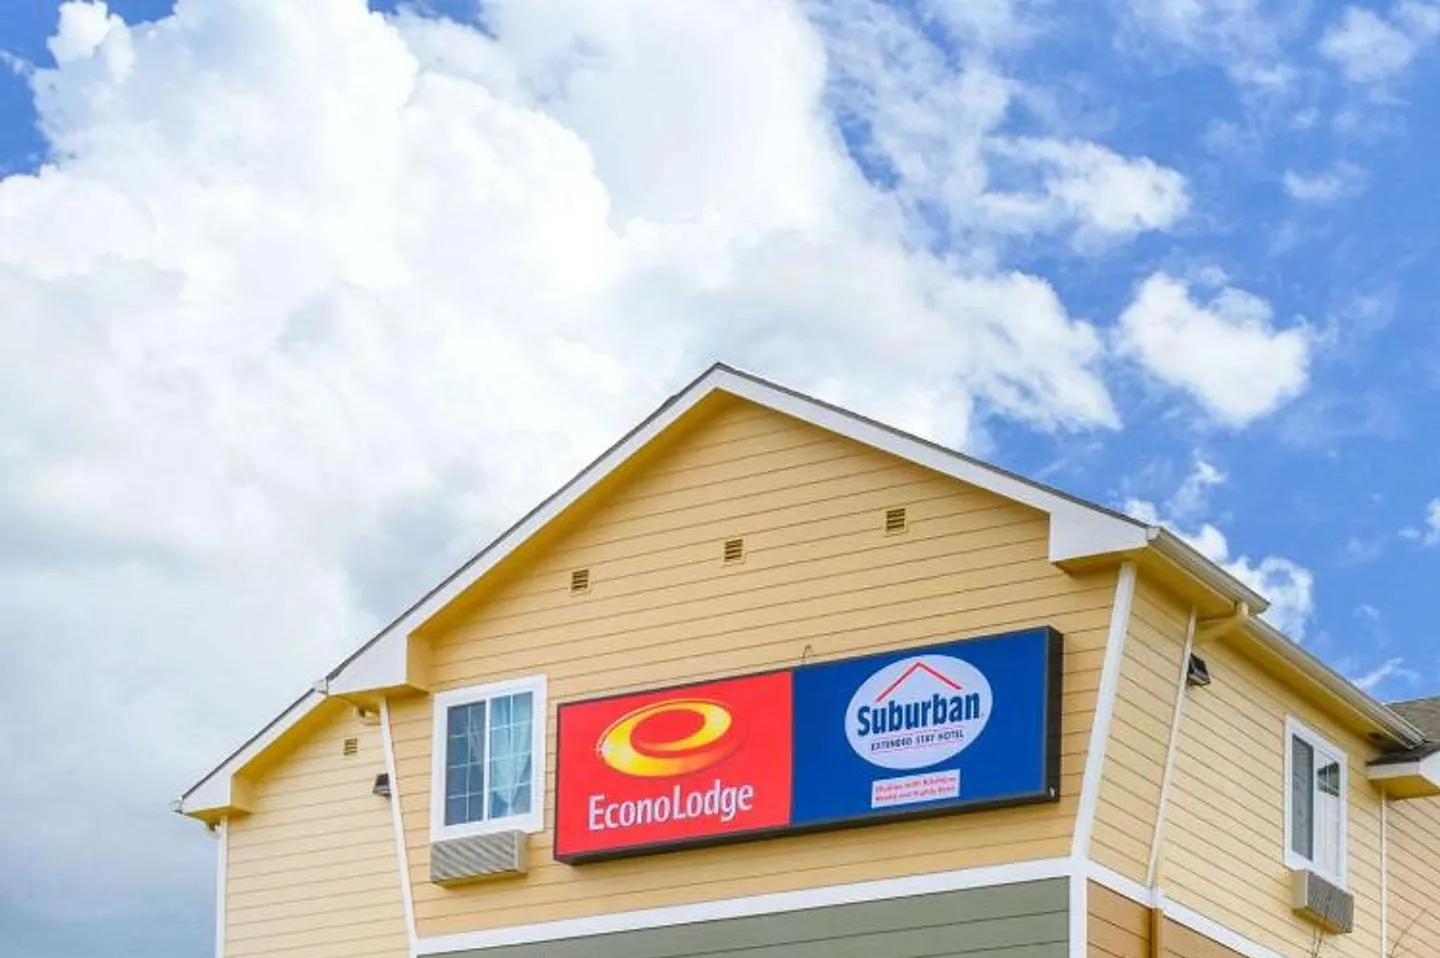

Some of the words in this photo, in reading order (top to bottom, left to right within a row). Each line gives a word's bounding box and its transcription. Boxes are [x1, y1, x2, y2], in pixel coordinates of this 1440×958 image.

[857, 692, 980, 737] Suburban
[871, 736, 913, 752] EXTENDED
[916, 734, 935, 745] STAY
[938, 729, 964, 741] HOTEL
[588, 778, 755, 831] EconoLodge
